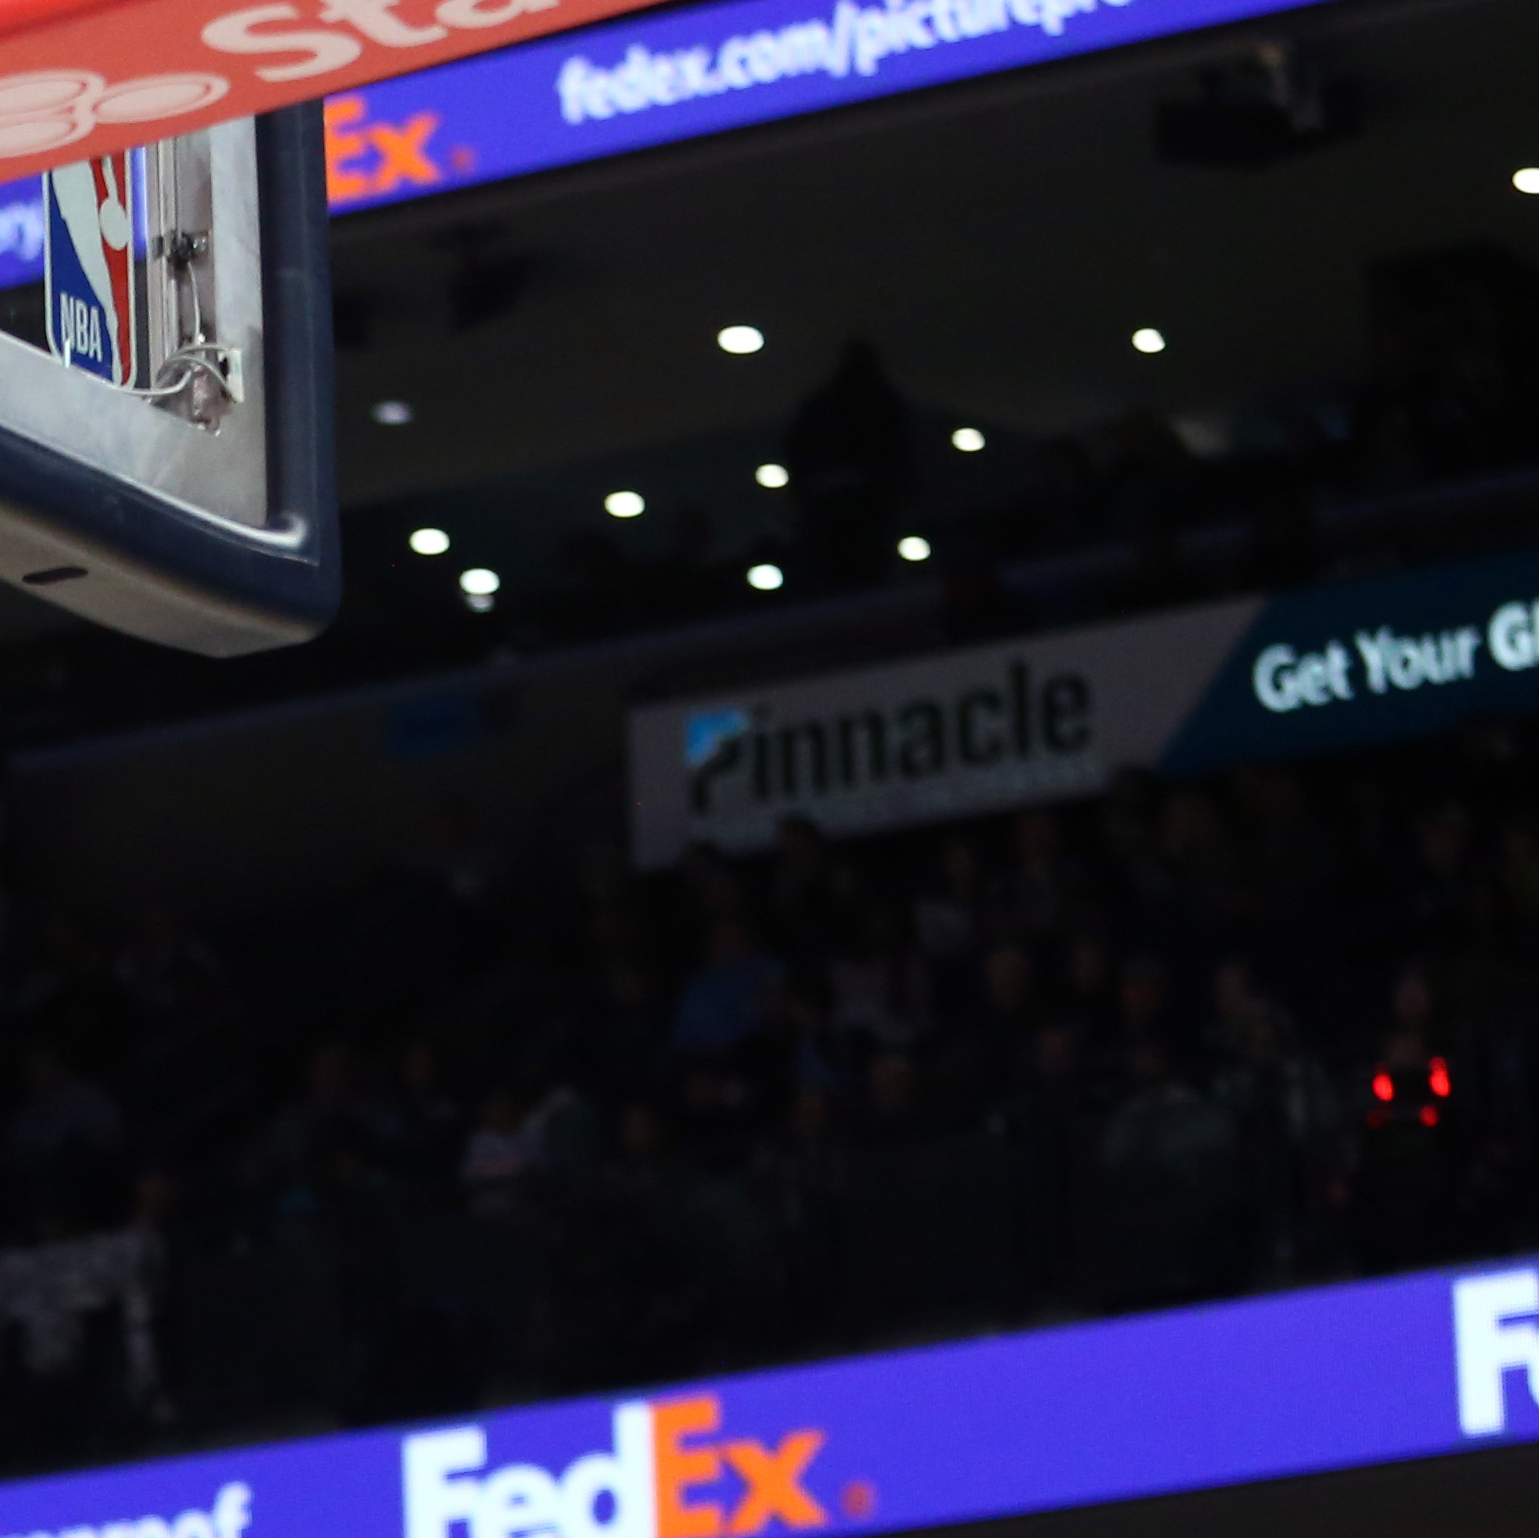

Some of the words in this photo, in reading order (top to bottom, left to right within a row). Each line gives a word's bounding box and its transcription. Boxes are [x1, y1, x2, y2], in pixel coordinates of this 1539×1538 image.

[60, 292, 103, 363] NBA
[1251, 642, 1354, 713] Get
[1354, 625, 1483, 694] Your
[1487, 598, 1539, 671] G
[685, 654, 1091, 817] Pinnacle
